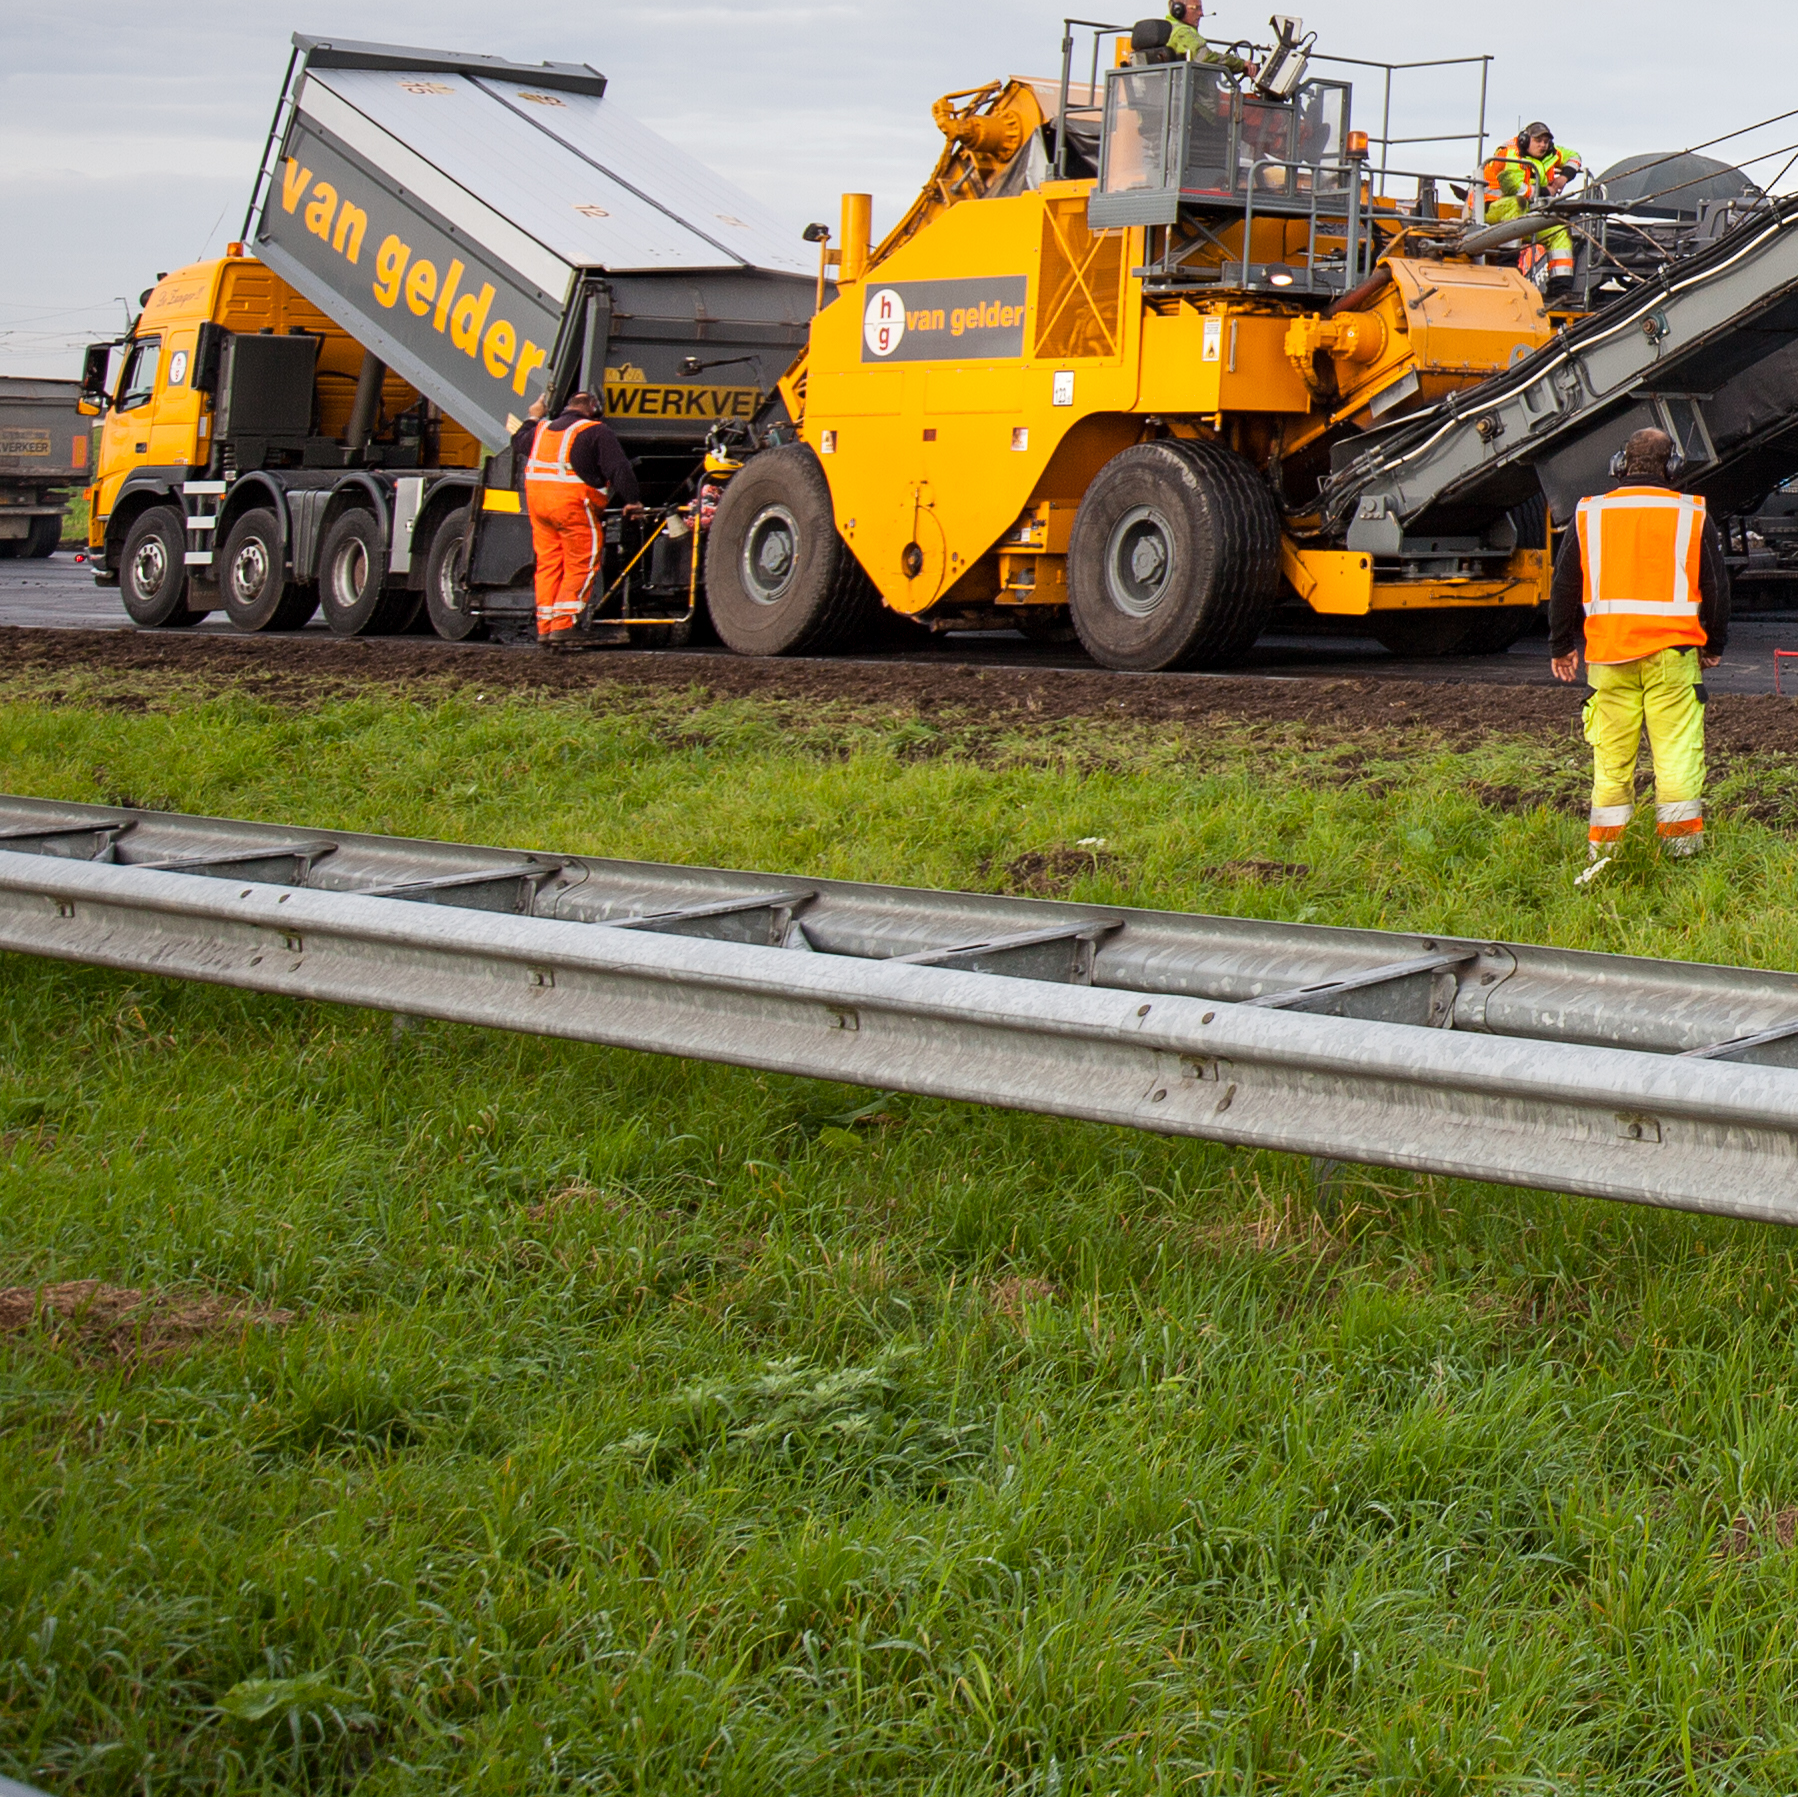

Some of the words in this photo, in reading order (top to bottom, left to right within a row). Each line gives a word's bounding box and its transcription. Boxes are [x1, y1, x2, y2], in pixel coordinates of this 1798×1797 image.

[282, 156, 368, 265] van
[373, 234, 547, 397] gelder
[880, 295, 892, 319] h
[905, 309, 945, 331] van
[950, 300, 1025, 336] gelder
[879, 326, 890, 351] g
[0, 442, 48, 452] VERKEER
